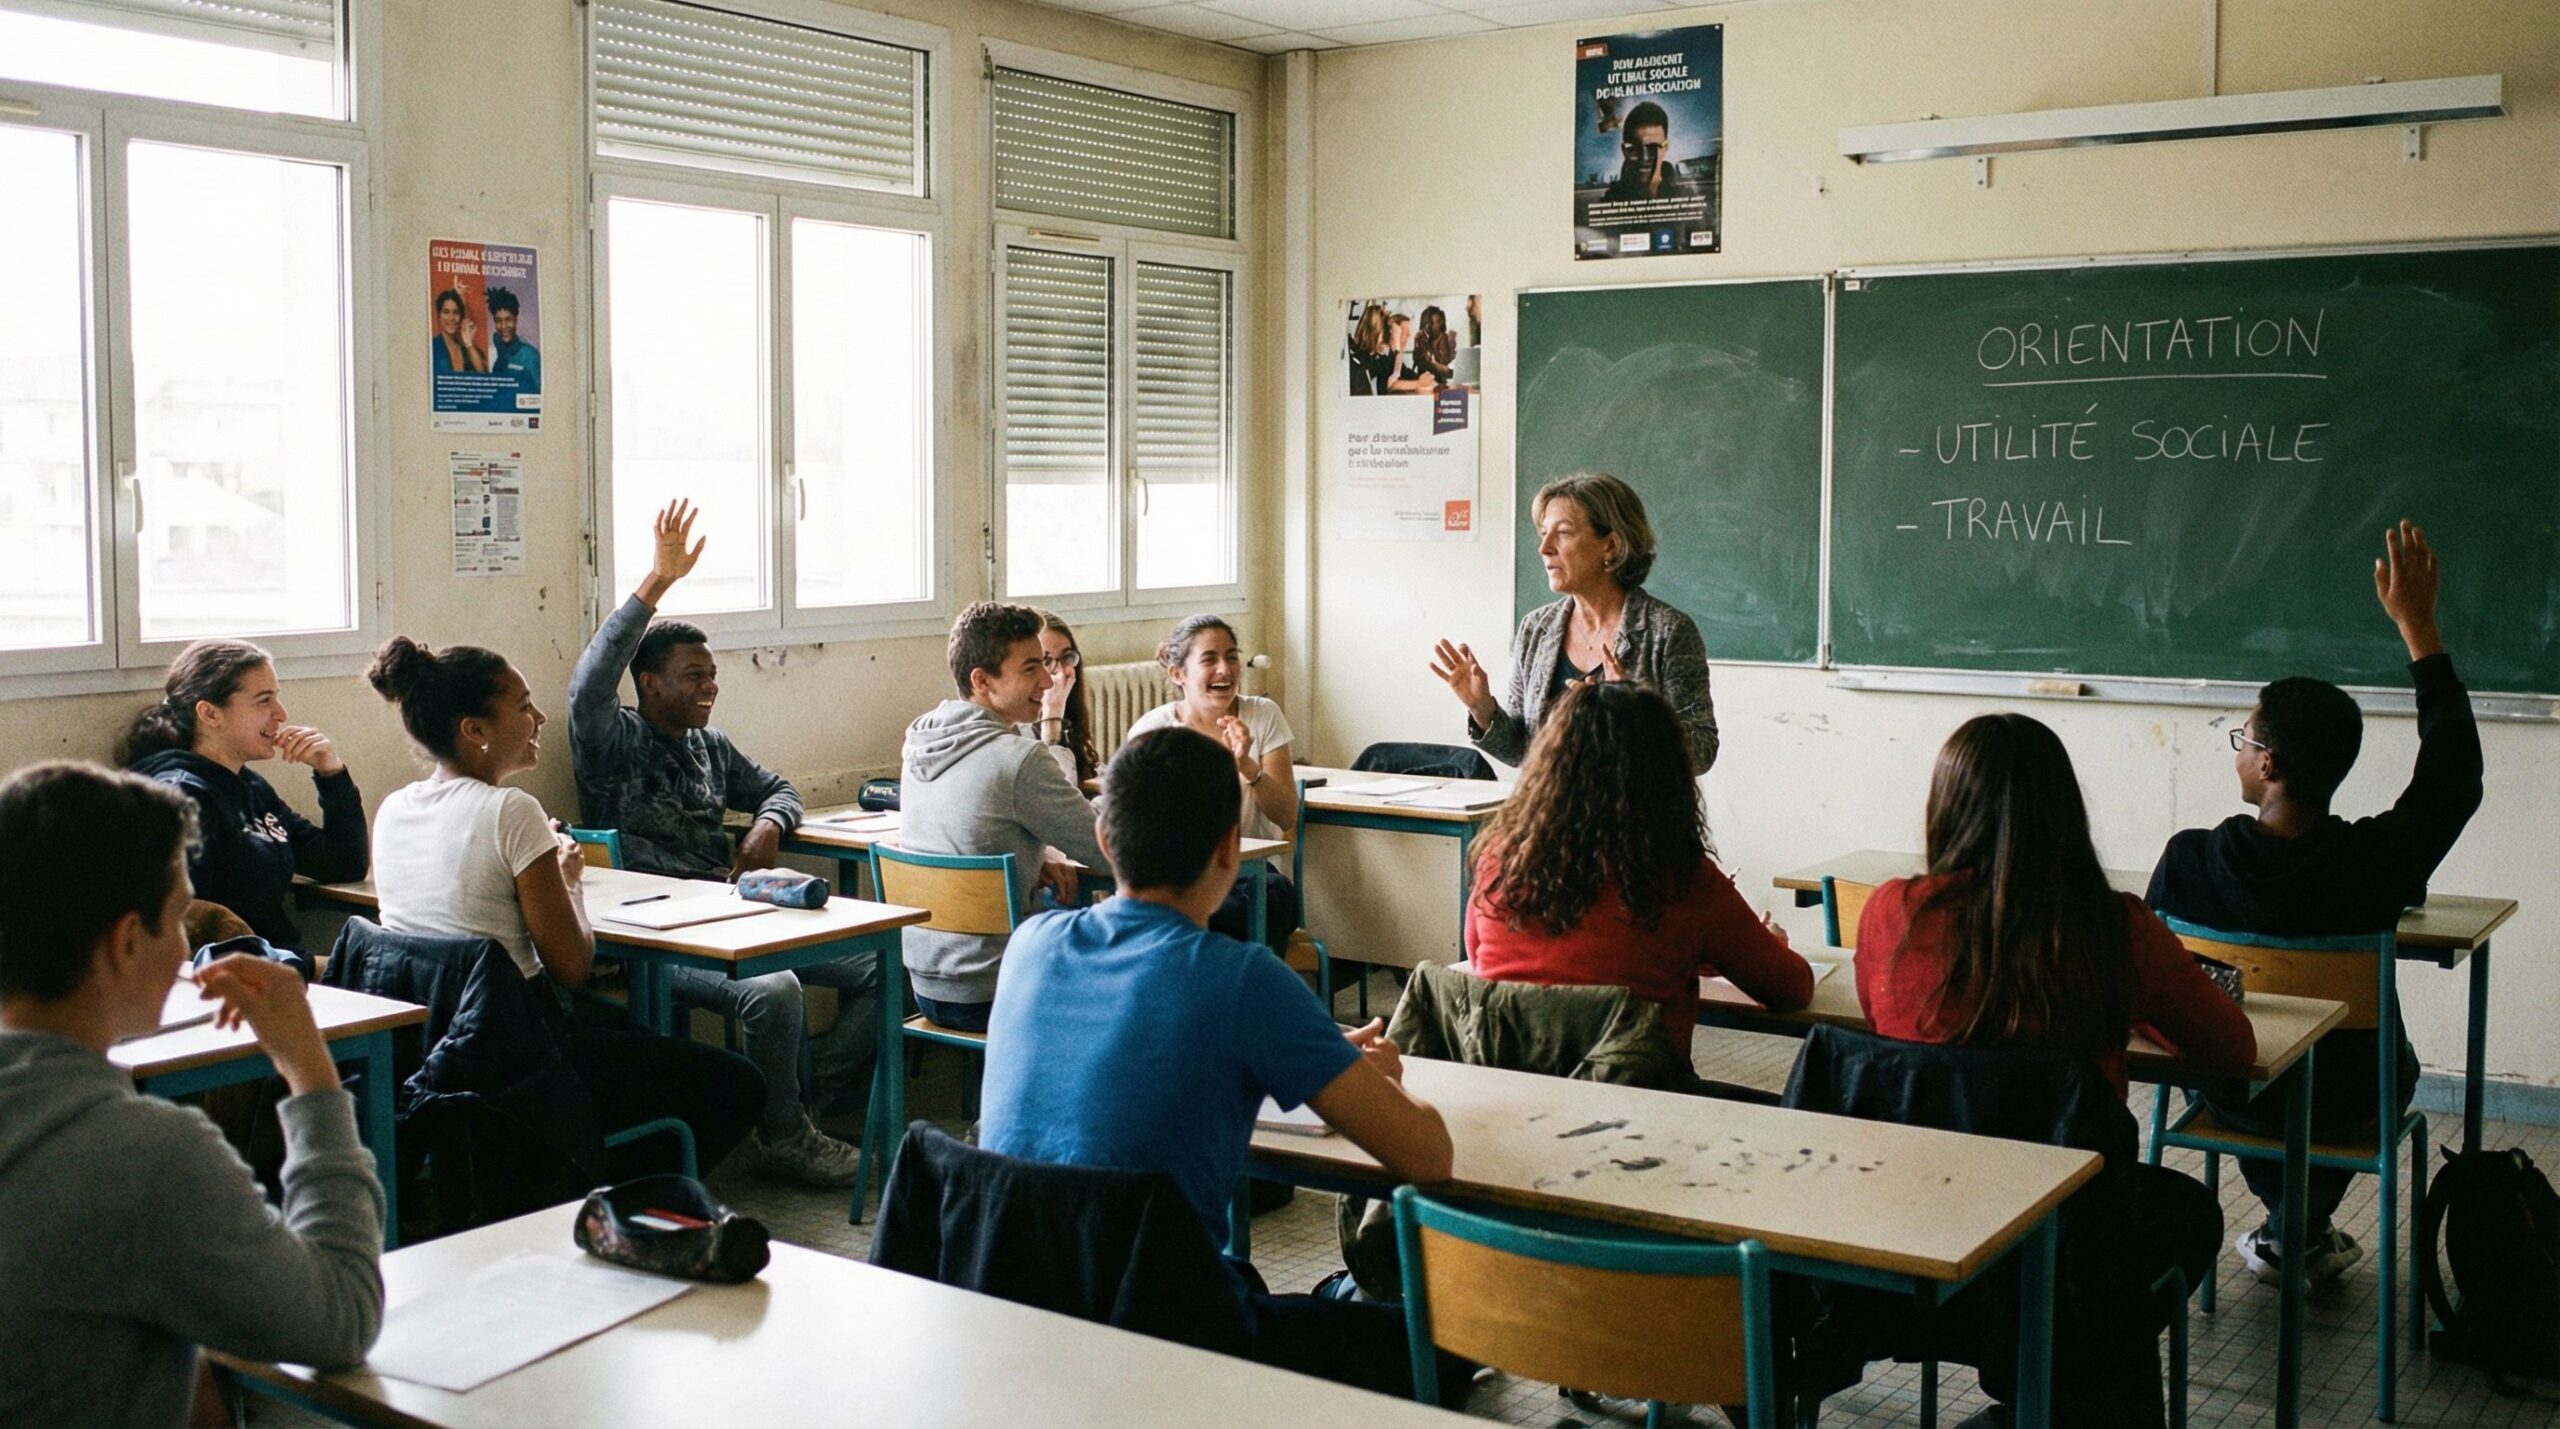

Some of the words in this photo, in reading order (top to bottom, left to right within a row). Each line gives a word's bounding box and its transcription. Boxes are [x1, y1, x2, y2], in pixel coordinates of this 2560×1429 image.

[1935, 401, 2099, 465] UTILITÉ
[2131, 414, 2331, 463] SOCIALE
[1930, 494, 2133, 546] TRAVAIL
